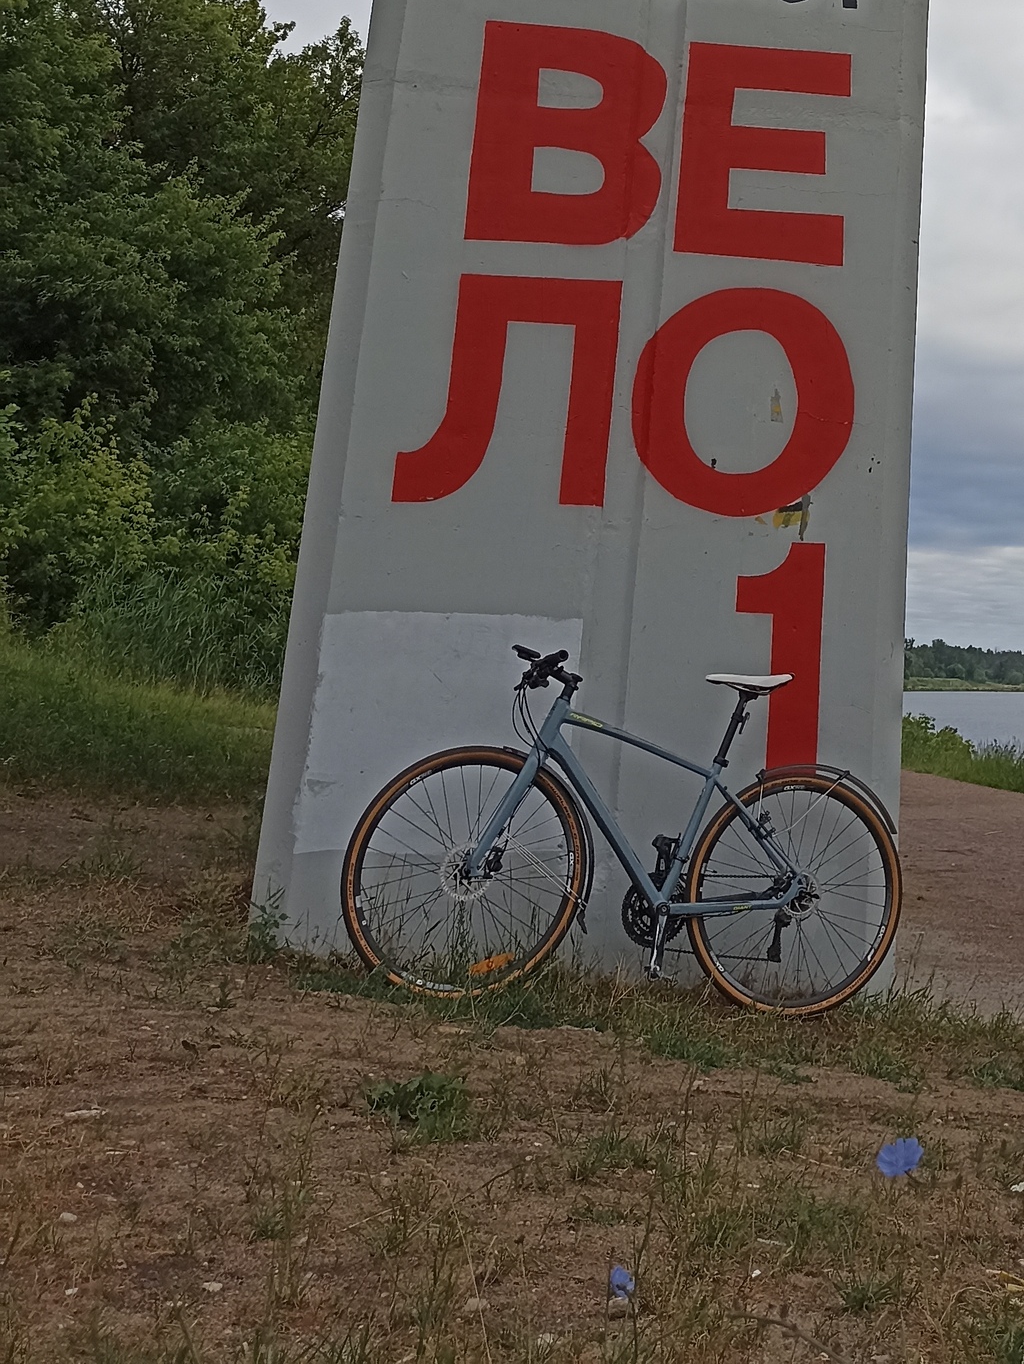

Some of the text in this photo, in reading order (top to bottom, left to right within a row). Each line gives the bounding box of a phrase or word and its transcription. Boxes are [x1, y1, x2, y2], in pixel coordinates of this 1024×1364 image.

[463, 19, 852, 267] ВЕ
[390, 272, 856, 518] ЛО
[735, 542, 826, 775] 1
